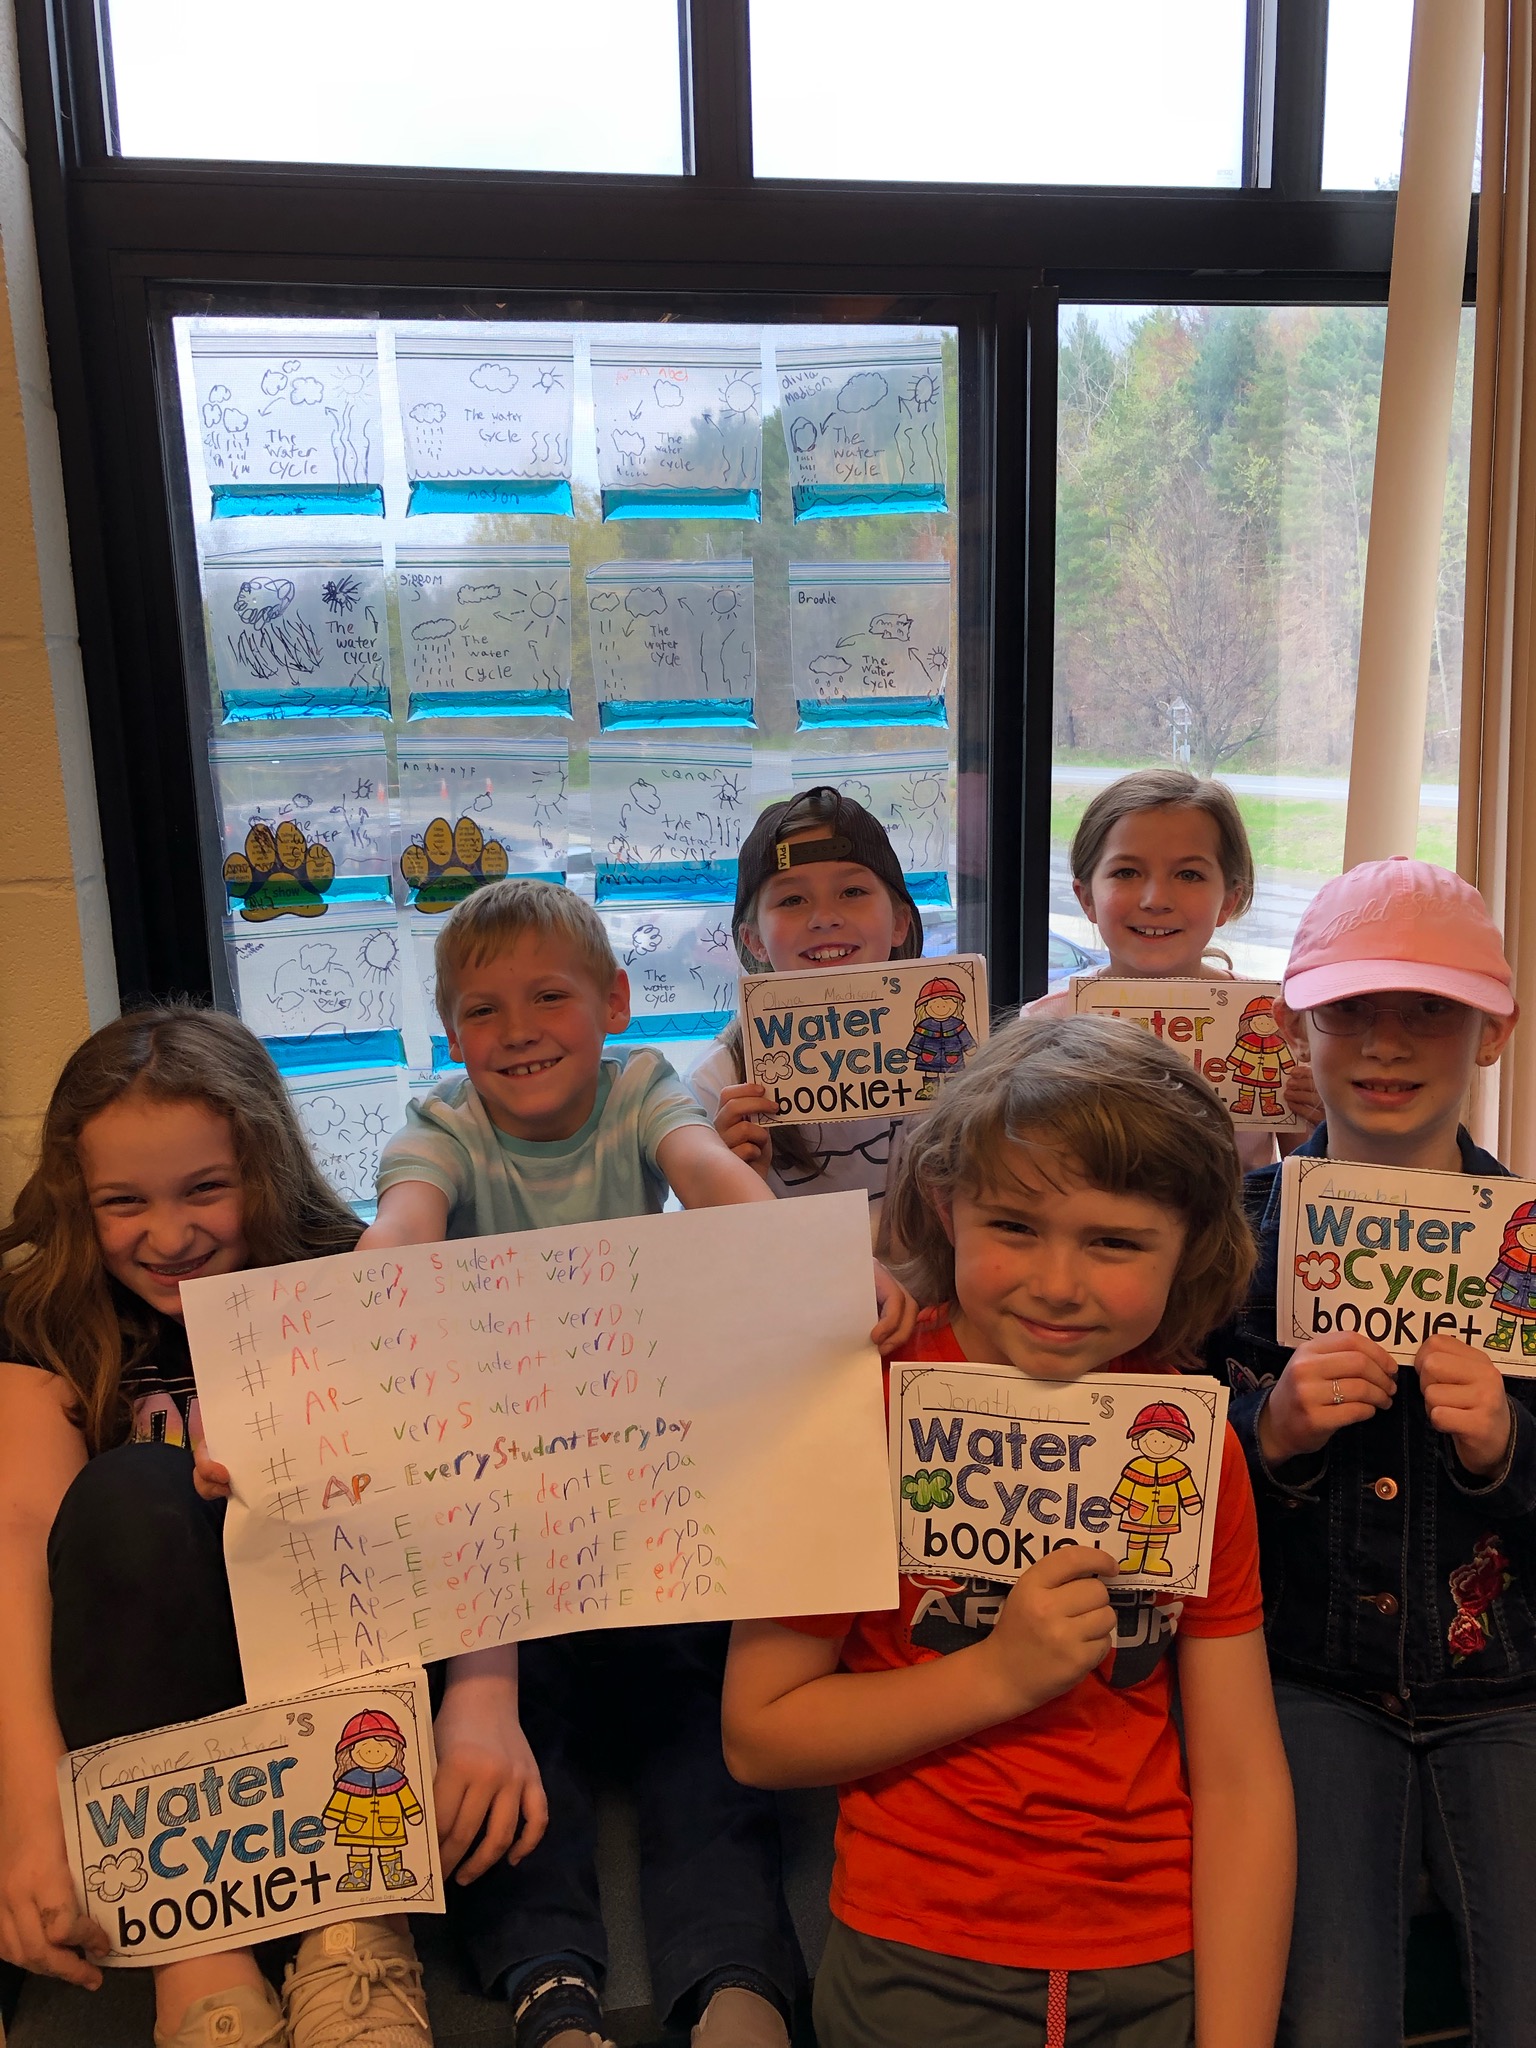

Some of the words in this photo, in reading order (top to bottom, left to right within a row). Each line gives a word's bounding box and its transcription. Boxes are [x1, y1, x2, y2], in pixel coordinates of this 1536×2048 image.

[832, 427, 865, 445] The
[797, 590, 836, 605] Brodie
[325, 621, 355, 635] The
[461, 635, 489, 646] The
[650, 624, 671, 637] The
[862, 654, 888, 666] The
[273, 886, 300, 898] show
[644, 968, 667, 983] The
[753, 1006, 891, 1050] Water
[792, 1041, 909, 1083] Cycle
[1305, 1203, 1475, 1254] Water
[1343, 1248, 1487, 1309] Cycle
[908, 1417, 1096, 1472] Water
[956, 1463, 1112, 1533] Cycle
[86, 1755, 299, 1848] Water
[148, 1809, 327, 1885] Cycle
